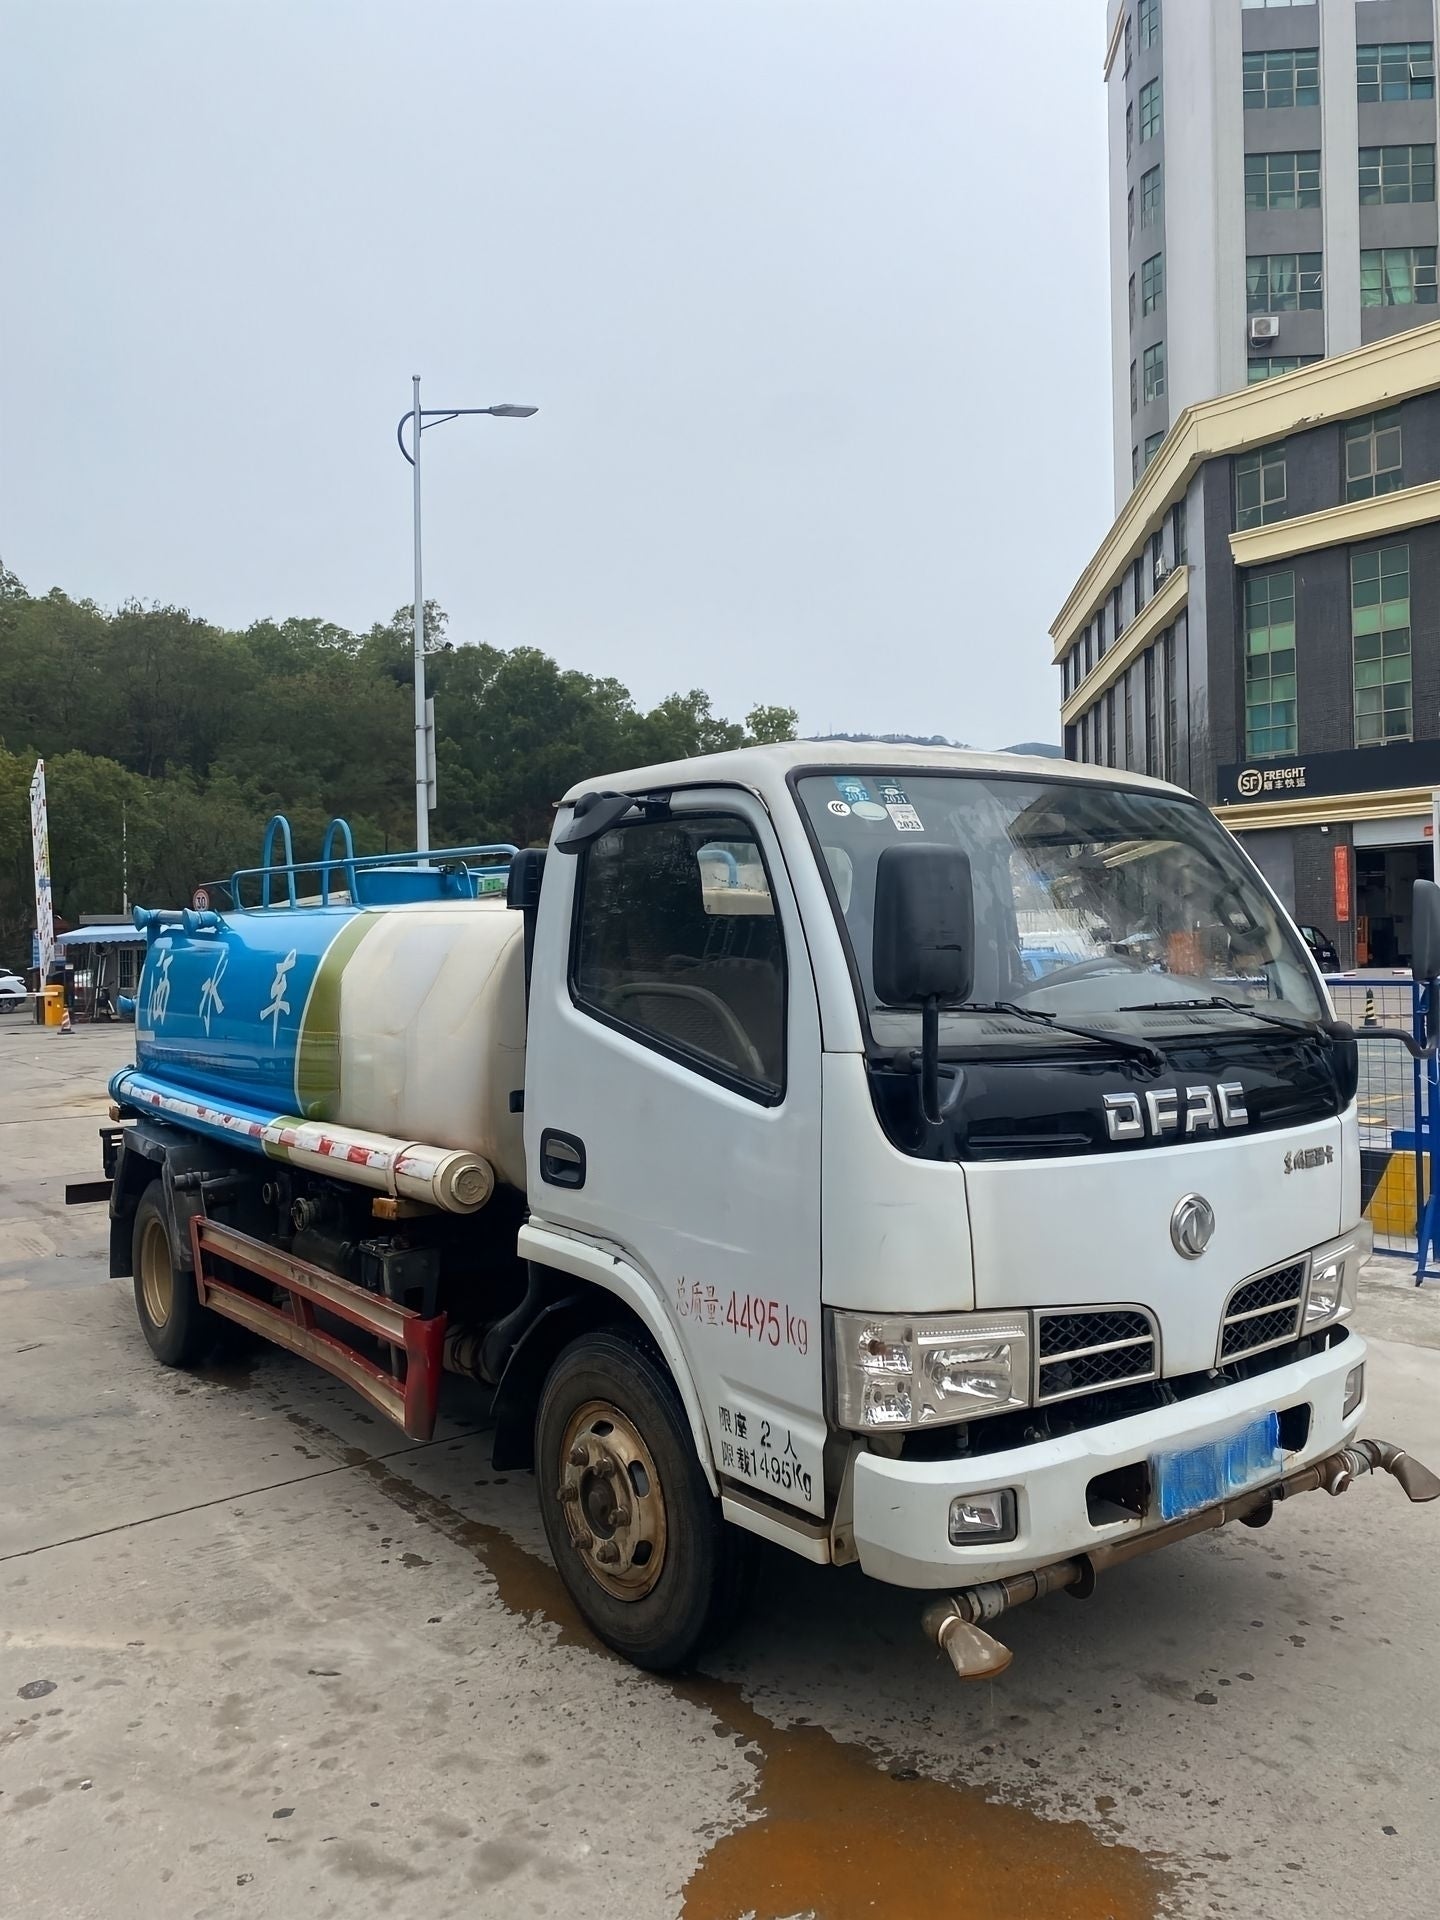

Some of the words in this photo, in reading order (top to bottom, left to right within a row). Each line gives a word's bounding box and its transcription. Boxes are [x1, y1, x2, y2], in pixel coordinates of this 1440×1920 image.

[1263, 766, 1306, 781] FREIGHT
[845, 791, 870, 801] 2022
[884, 794, 907, 803] 2021
[897, 820, 921, 830] 2023
[147, 948, 297, 1049] 洒水车
[1102, 1081, 1249, 1141] DFAC
